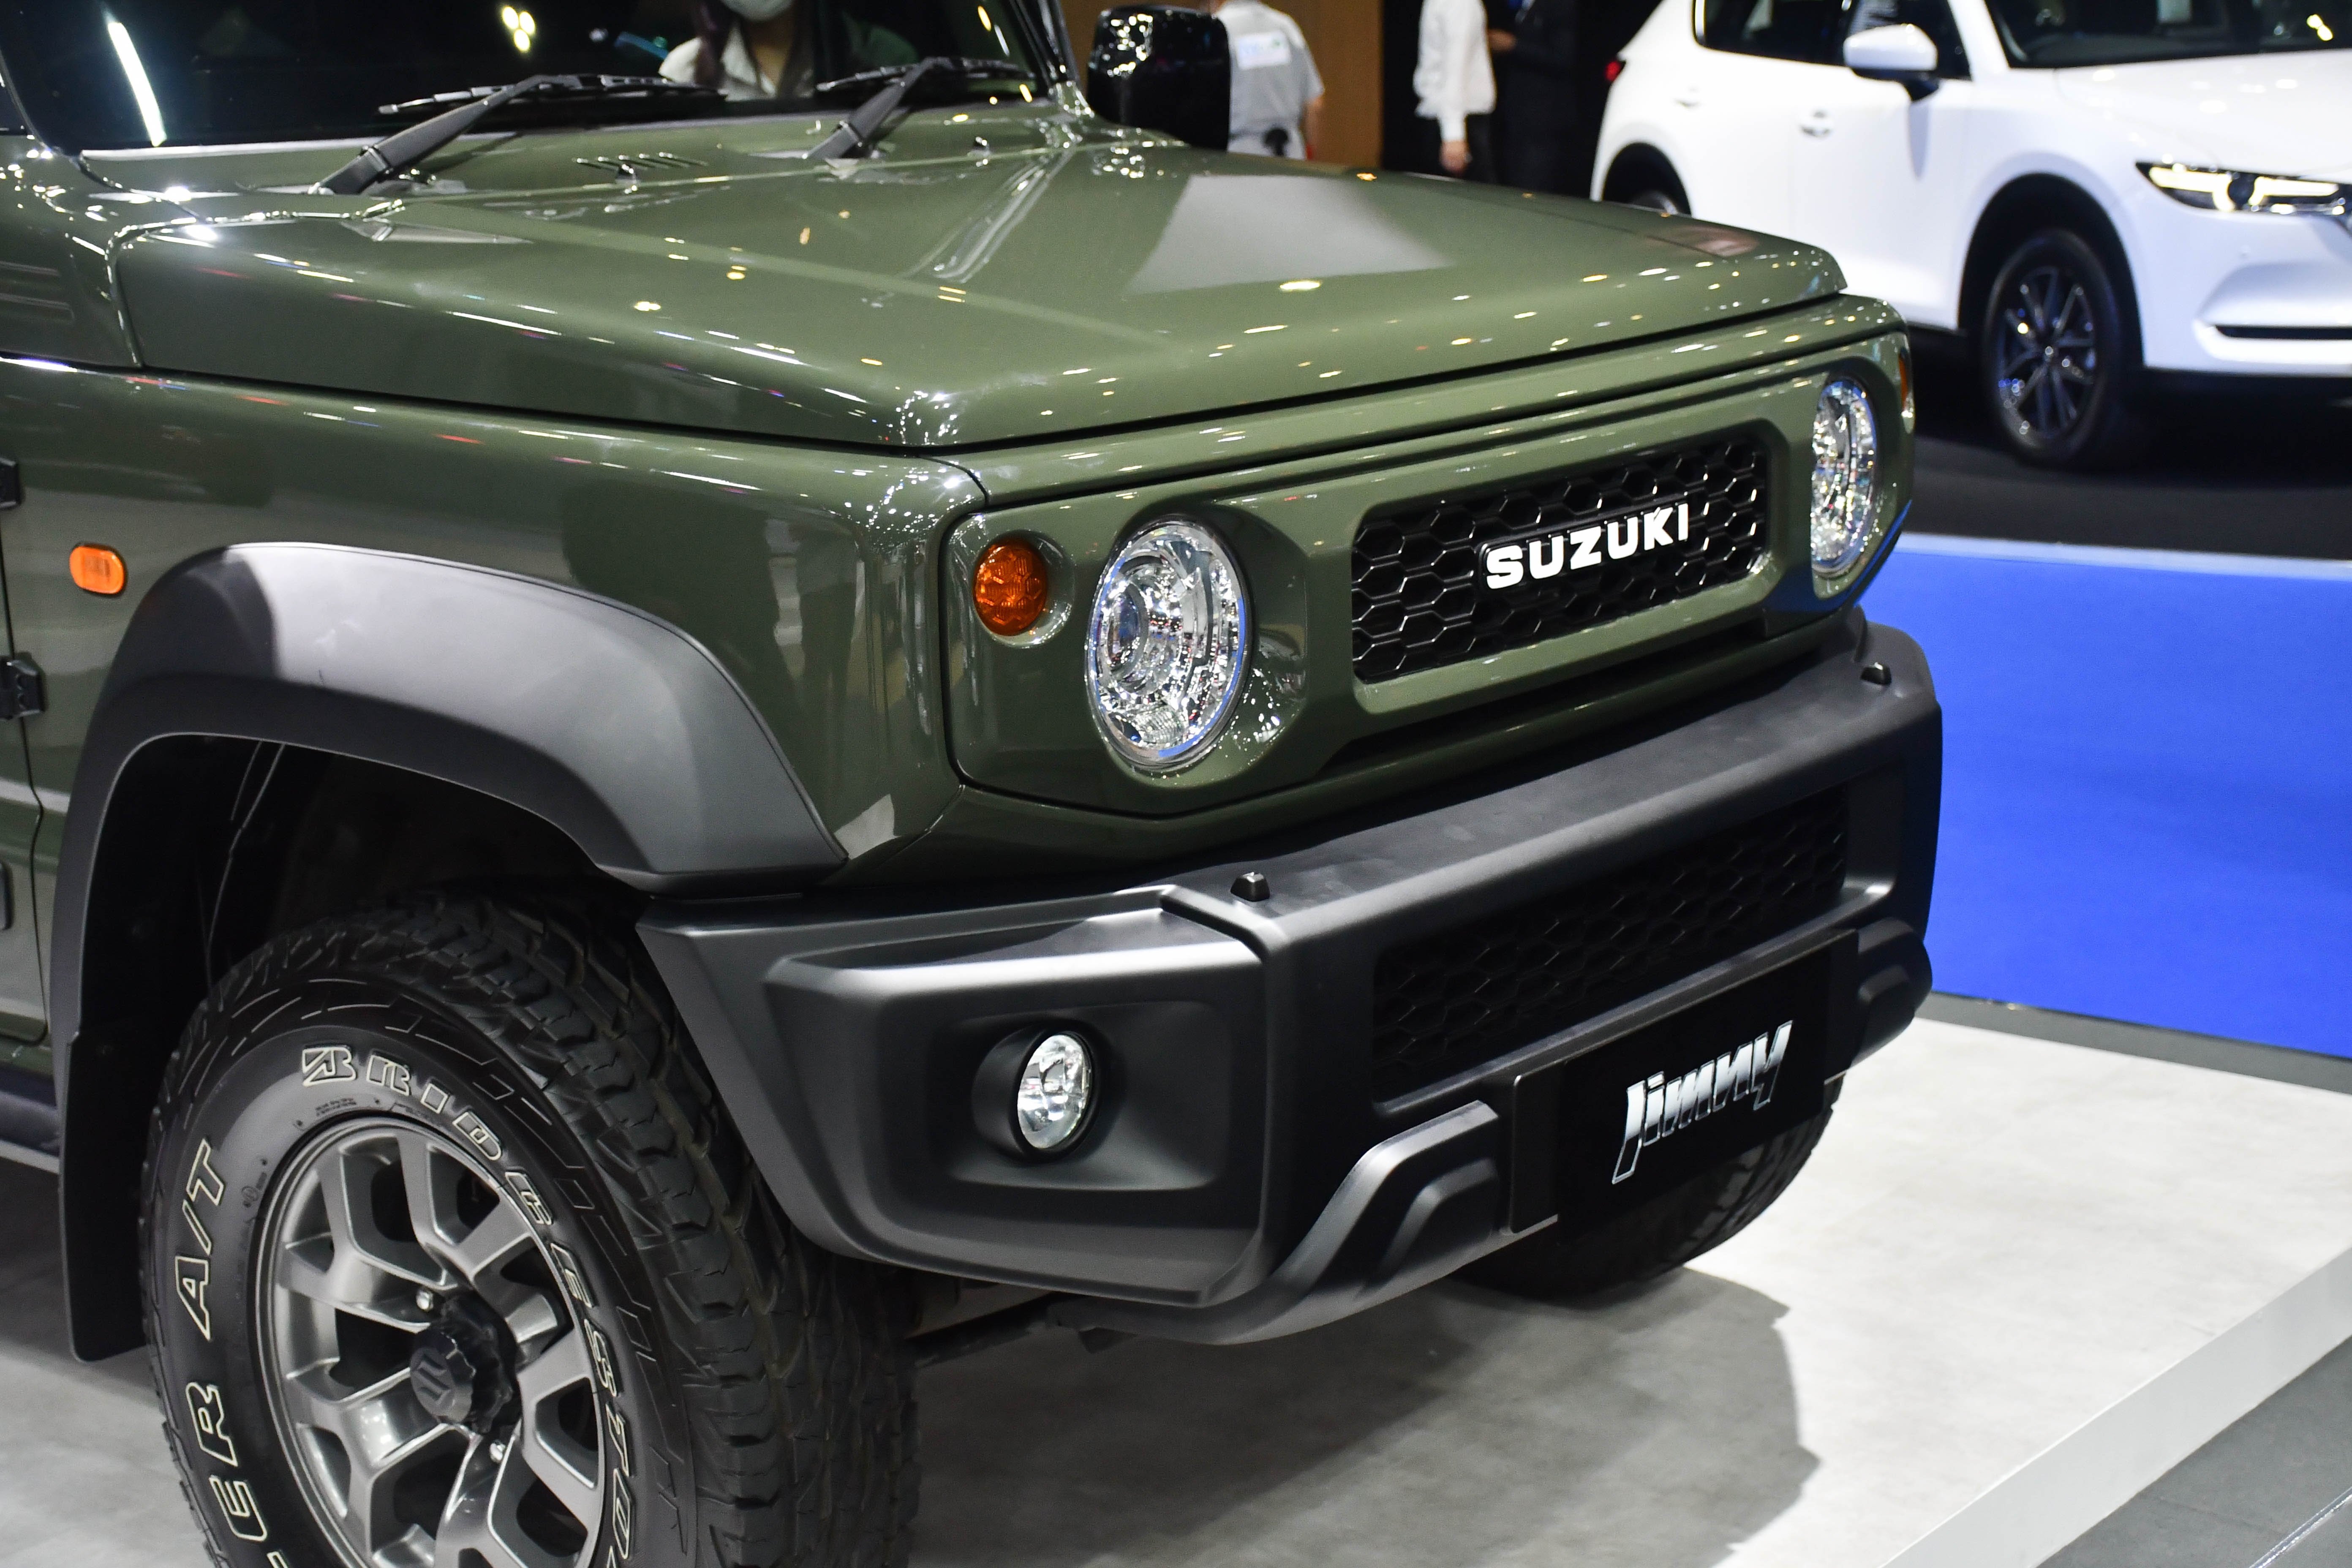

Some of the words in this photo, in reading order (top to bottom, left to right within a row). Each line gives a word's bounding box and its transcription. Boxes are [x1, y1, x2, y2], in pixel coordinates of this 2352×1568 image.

[1486, 503, 1688, 589] SUZUKI
[175, 1139, 226, 1340] A/T
[185, 1382, 289, 1568] ER
